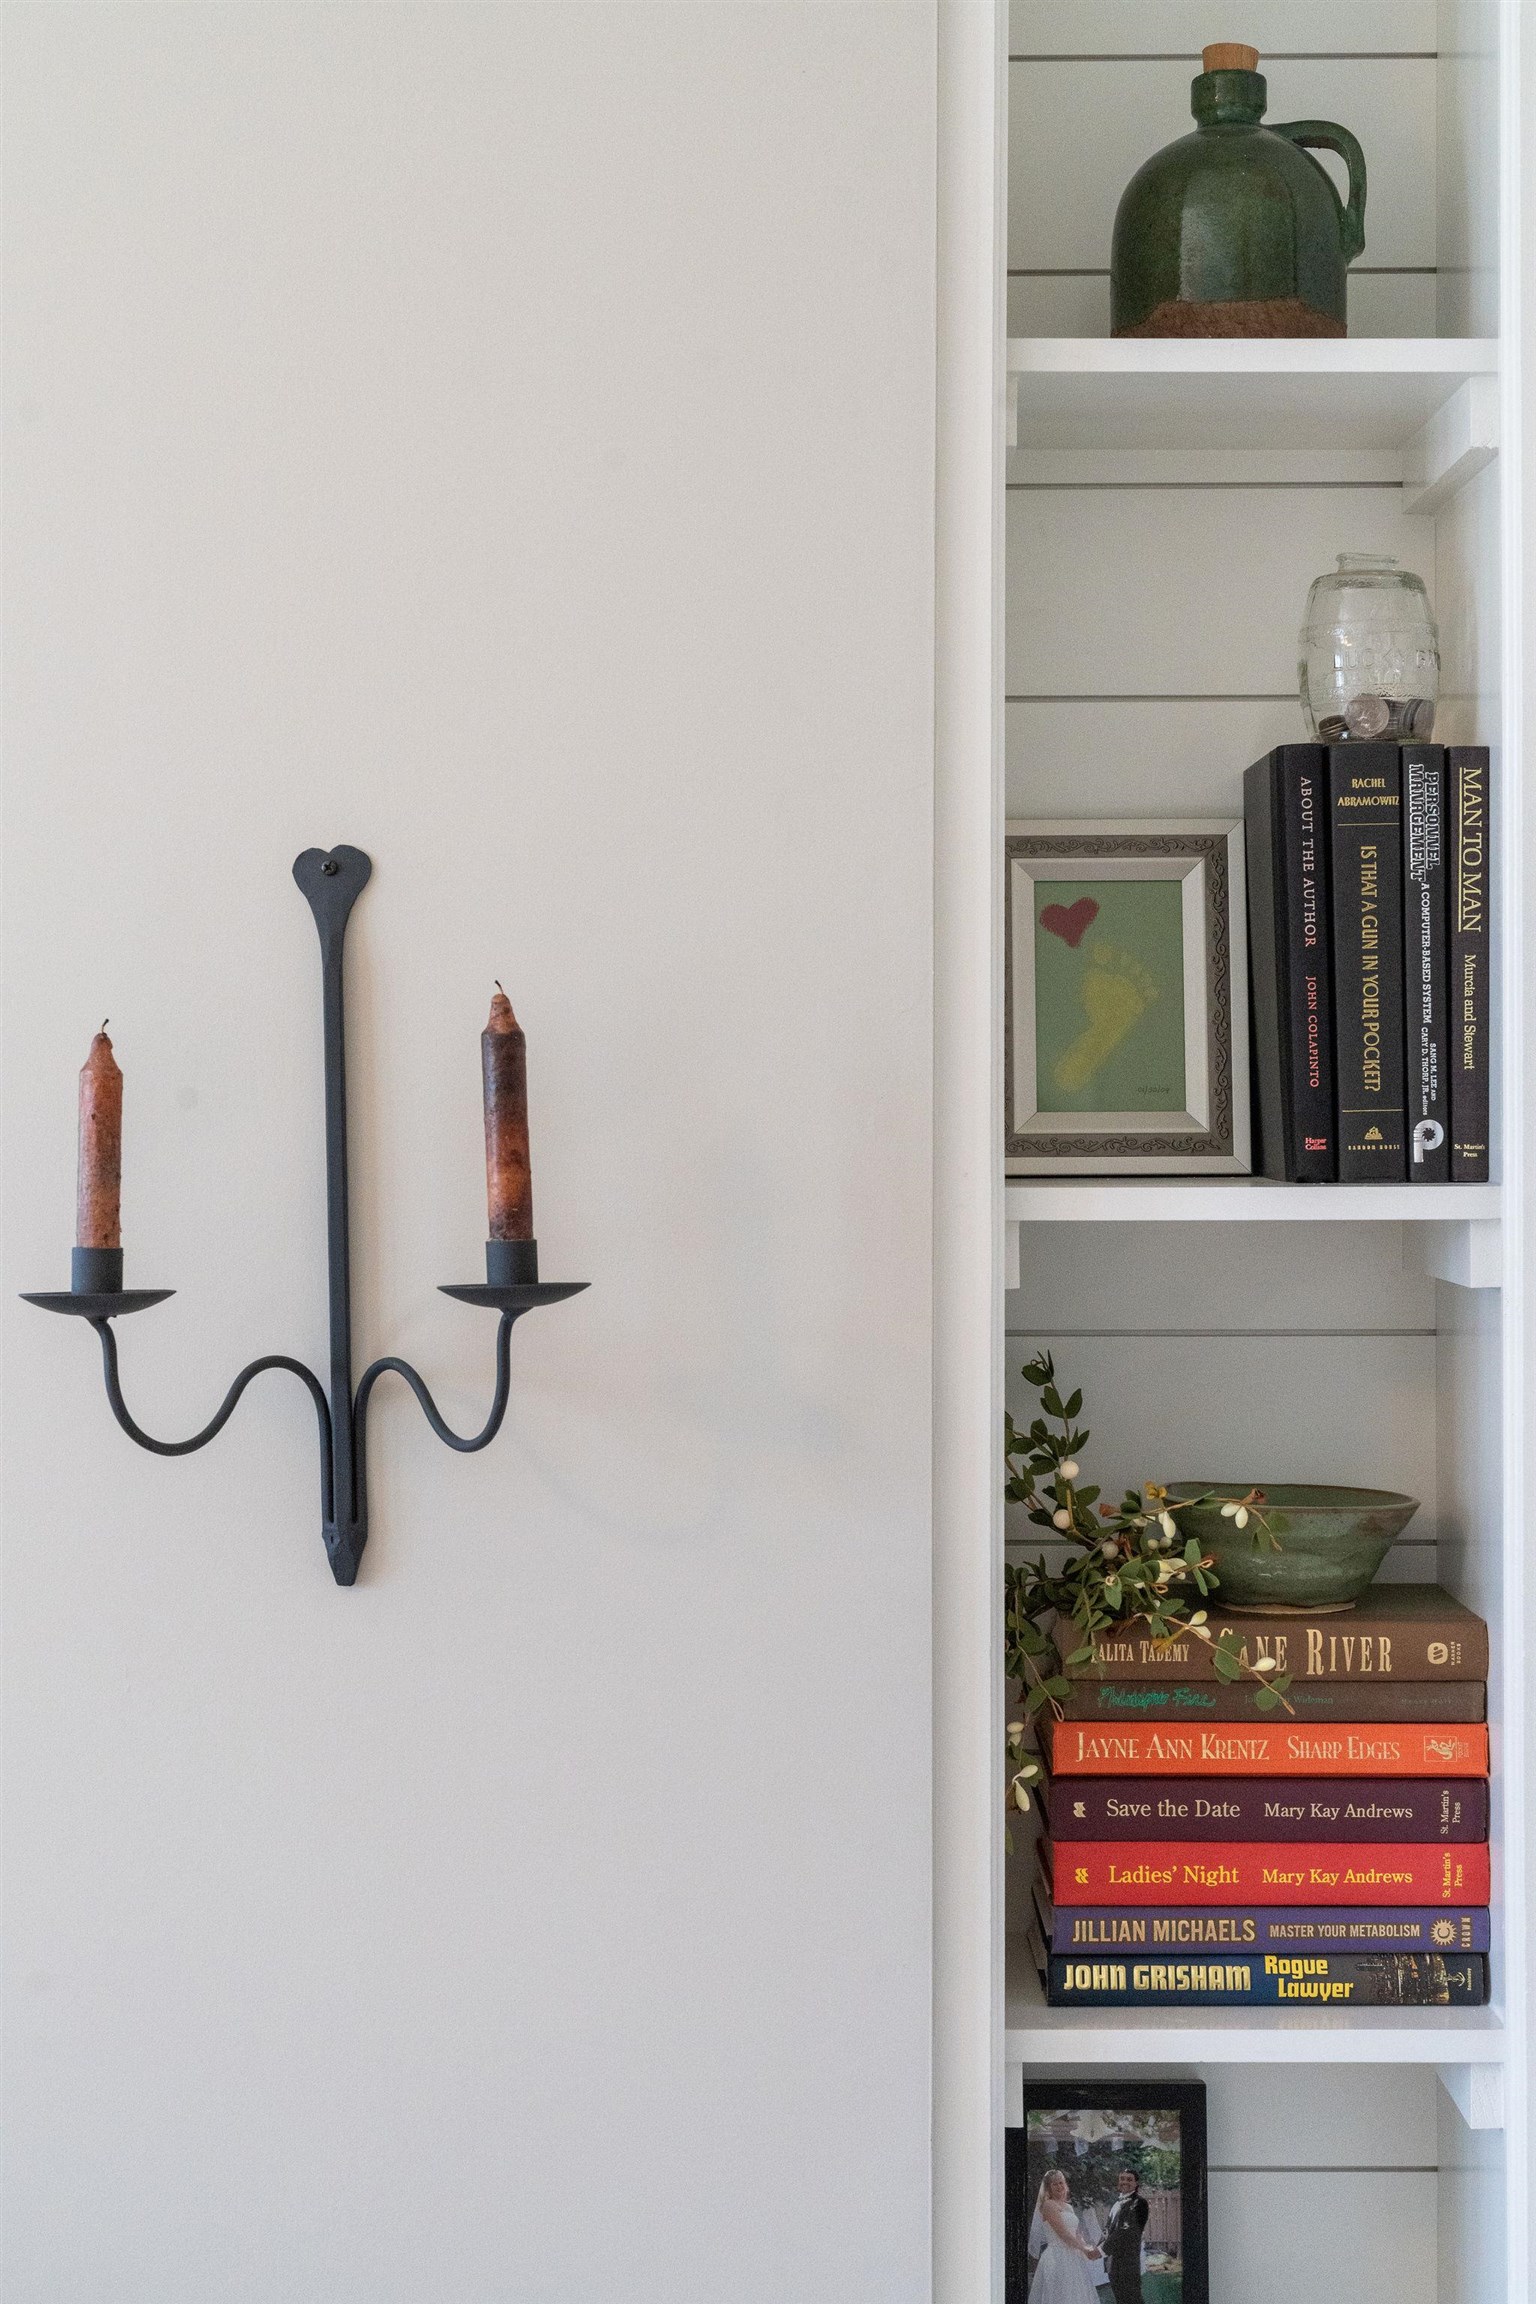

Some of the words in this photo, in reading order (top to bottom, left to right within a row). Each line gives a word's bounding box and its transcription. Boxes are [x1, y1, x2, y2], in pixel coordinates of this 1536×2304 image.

[1351, 778, 1386, 788] RACHEL
[1463, 767, 1482, 827] MAN
[1300, 776, 1313, 833] ABOUT
[1337, 796, 1400, 807] ABRAMOWITZ
[1408, 763, 1426, 882] MANAGEMENT
[1425, 771, 1440, 870] PERSONNEL
[1302, 838, 1315, 871] THE
[1360, 845, 1377, 859] IS
[1463, 832, 1482, 867] TO
[1360, 862, 1378, 898] THAT
[1421, 883, 1430, 891] A
[1303, 877, 1316, 947] AUTHOR
[1361, 901, 1378, 912] A
[1462, 872, 1482, 933] MAN
[1361, 914, 1379, 950] GUN
[1362, 955, 1378, 970] IN
[1464, 954, 1477, 996] Murcia
[1305, 976, 1317, 1010] JOHN
[1363, 974, 1380, 1020] YOUR
[1422, 984, 1432, 1024] SYSTEM
[1464, 999, 1477, 1022] and
[1307, 1015, 1320, 1088] COLAPINTO
[1363, 1023, 1381, 1092] POCKET?
[1464, 1024, 1477, 1070] Stewart
[1430, 1065, 1437, 1074] M.
[1305, 1137, 1327, 1145] Harper
[1305, 1629, 1392, 1675] RIVER
[1076, 1732, 1139, 1762] JAYNE
[1146, 1734, 1192, 1760] ANN
[1201, 1734, 1270, 1760] KRENTZ
[1287, 1735, 1342, 1760] SHARP
[1346, 1736, 1400, 1760] EDGES
[1106, 1799, 1151, 1818] Save
[1157, 1799, 1189, 1817] the
[1194, 1799, 1241, 1818] Date
[1264, 1803, 1305, 1820] Mary
[1310, 1803, 1341, 1820] Kay
[1344, 1803, 1413, 1818] Andrews
[1440, 1790, 1449, 1822] Martin's
[1451, 1802, 1461, 1823] Press
[1440, 1824, 1449, 1834] St.
[1183, 1865, 1240, 1887] Night
[1262, 1868, 1305, 1886] Mary
[1309, 1868, 1341, 1886] Kay
[1343, 1868, 1413, 1883] Andrews
[1442, 1852, 1451, 1886] Martin's
[1454, 1864, 1463, 1887] Press
[1442, 1887, 1451, 1898] St.
[1072, 1920, 1146, 1942] JILLIAN
[1153, 1919, 1256, 1942] MICHAELS
[1269, 1925, 1314, 1938] MASTER
[1317, 1925, 1347, 1937] YOUR
[1350, 1924, 1420, 1938] METABOLISM
[1461, 1917, 1471, 1948] CROWN
[1063, 1964, 1127, 1990] JOHN
[1133, 1964, 1252, 1991] GRISHAM
[1264, 1955, 1329, 1979] Rogue
